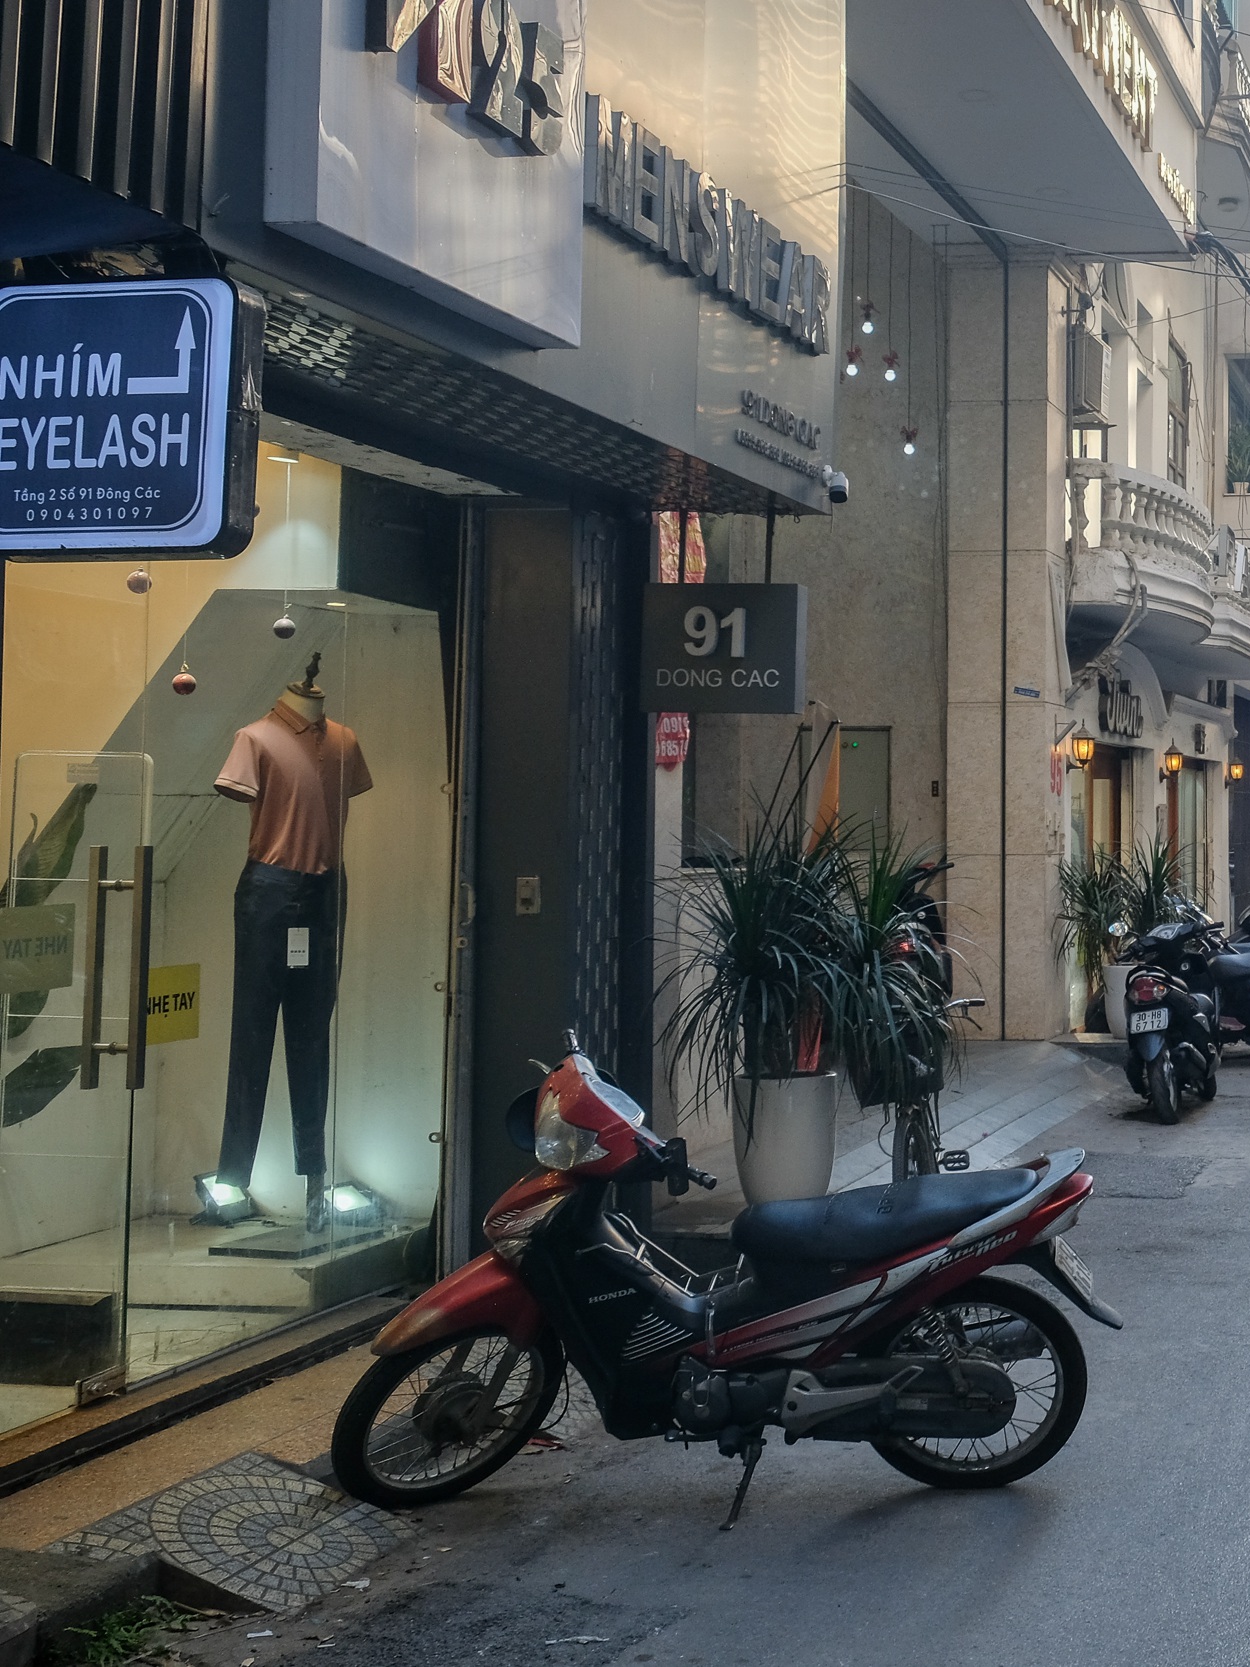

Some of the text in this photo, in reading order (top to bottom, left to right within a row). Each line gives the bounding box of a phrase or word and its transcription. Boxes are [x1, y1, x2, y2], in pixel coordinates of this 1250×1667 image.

[585, 91, 831, 356] MENSWEAR
[0, 343, 122, 400] NHÍM
[0, 413, 189, 471] EYELASH
[13, 486, 161, 504] Tầng 2 Số 91 Đông Các
[26, 506, 153, 521] 0904301097
[683, 605, 746, 658] 91
[656, 668, 780, 688] DONG CAC
[172, 991, 196, 1012] TAY
[1135, 1020, 1162, 1032] 6712
[588, 1287, 637, 1304] HONDA
